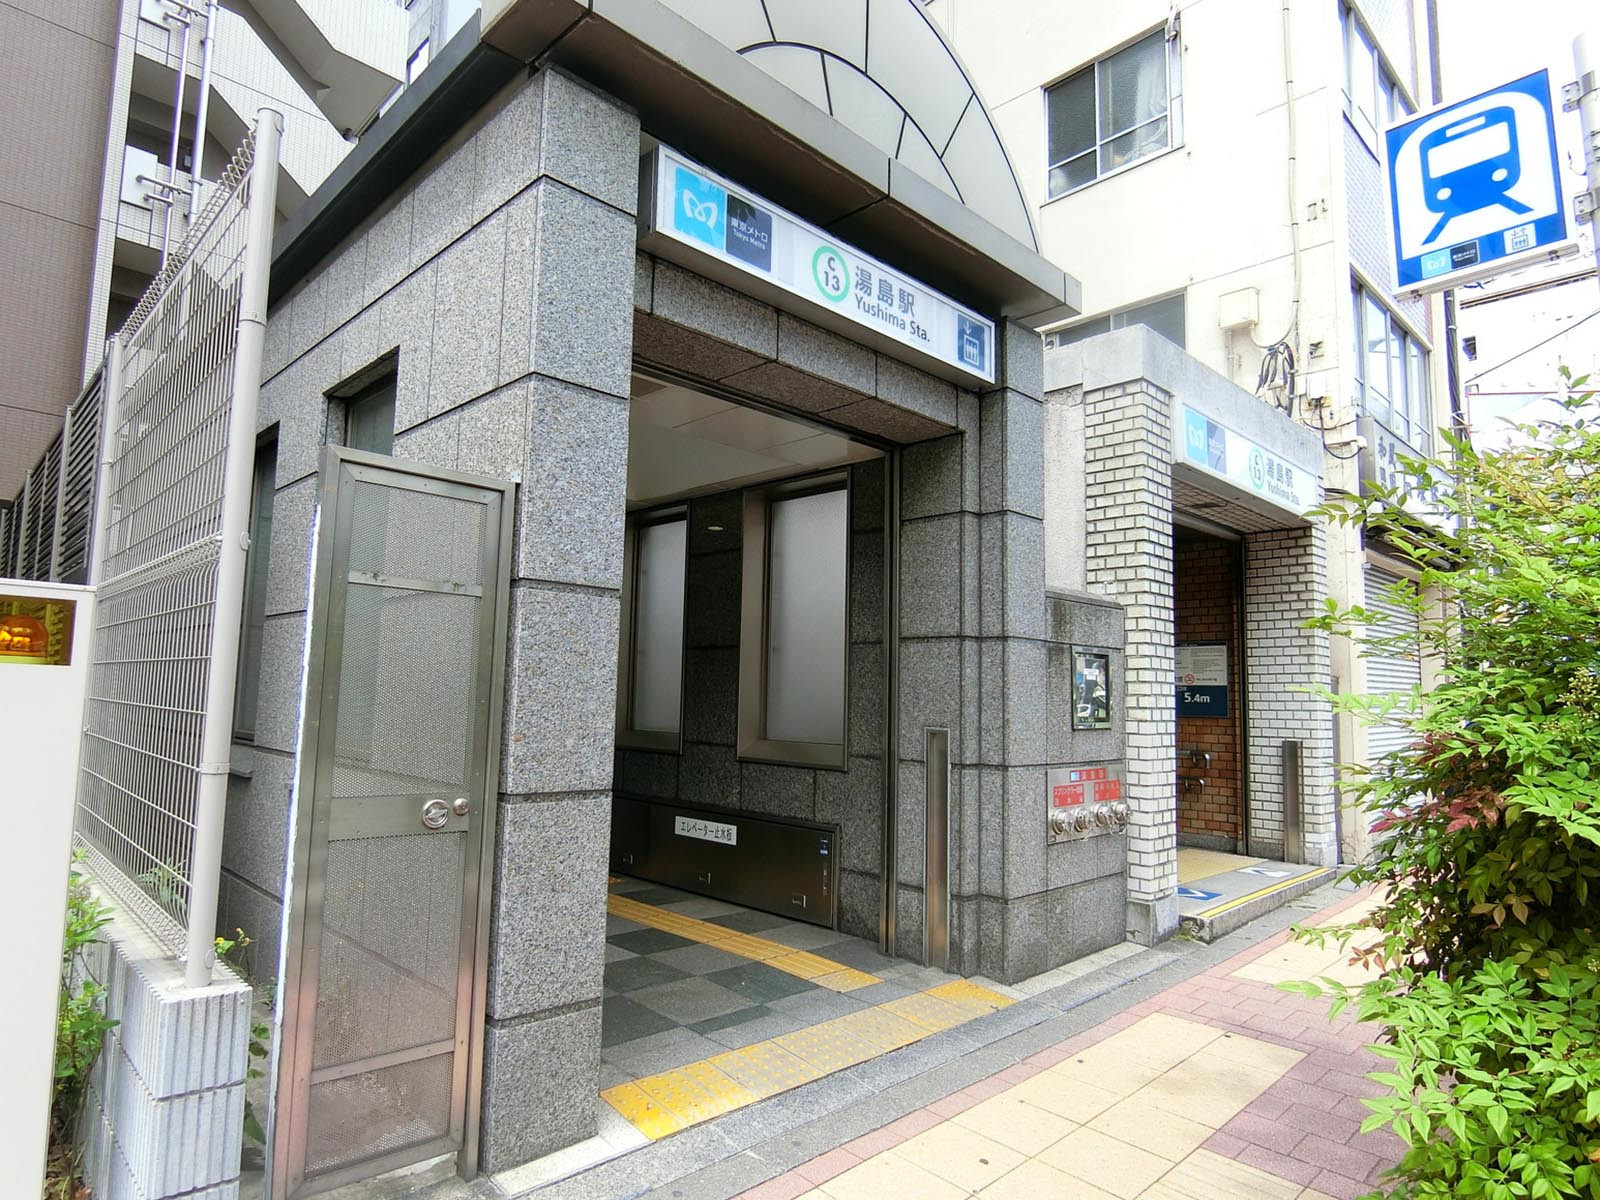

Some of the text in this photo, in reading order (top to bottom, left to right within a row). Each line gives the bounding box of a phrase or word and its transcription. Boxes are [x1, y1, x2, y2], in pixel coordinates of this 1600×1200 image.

[731, 217, 768, 243] 東京メトロ
[733, 228, 766, 250] Tokyo Metro
[827, 257, 836, 272] C
[823, 271, 841, 292] 13
[854, 265, 915, 318] 湯島駅
[854, 293, 931, 343] Yushima Sta.
[1184, 692, 1210, 703] 5.4m
[680, 821, 733, 842] エレベーター止水板
